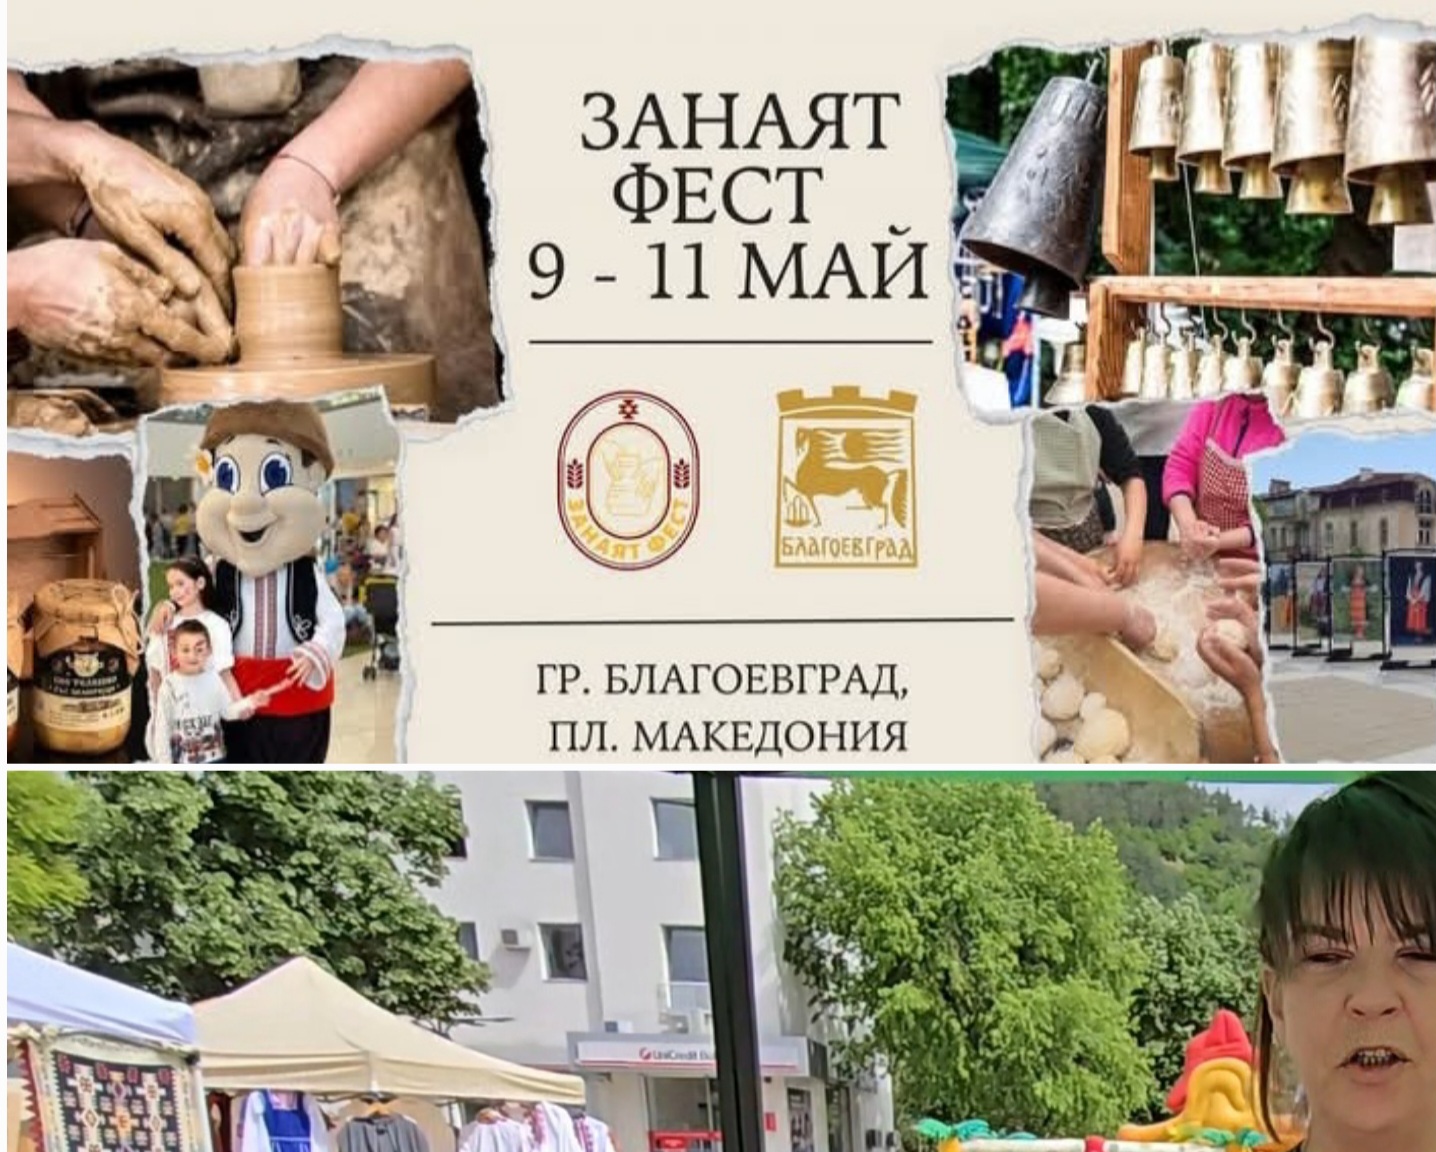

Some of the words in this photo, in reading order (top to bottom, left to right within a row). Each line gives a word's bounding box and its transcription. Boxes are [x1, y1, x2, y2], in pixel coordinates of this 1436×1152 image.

[581, 91, 900, 150] ЗАНАЯТ
[613, 162, 823, 225] ФЕСТ
[528, 242, 564, 299] 9
[648, 243, 709, 299] 11
[738, 225, 929, 299] МАЙ
[567, 498, 641, 560] ЗАНАЯТ
[648, 498, 689, 557] ФЕСТ
[536, 665, 589, 695] ГР.
[605, 664, 908, 700] БЛАГОЕВГРАД,
[550, 721, 616, 752] ПЛ.
[633, 721, 908, 758] МАКЕДОНИЯ
